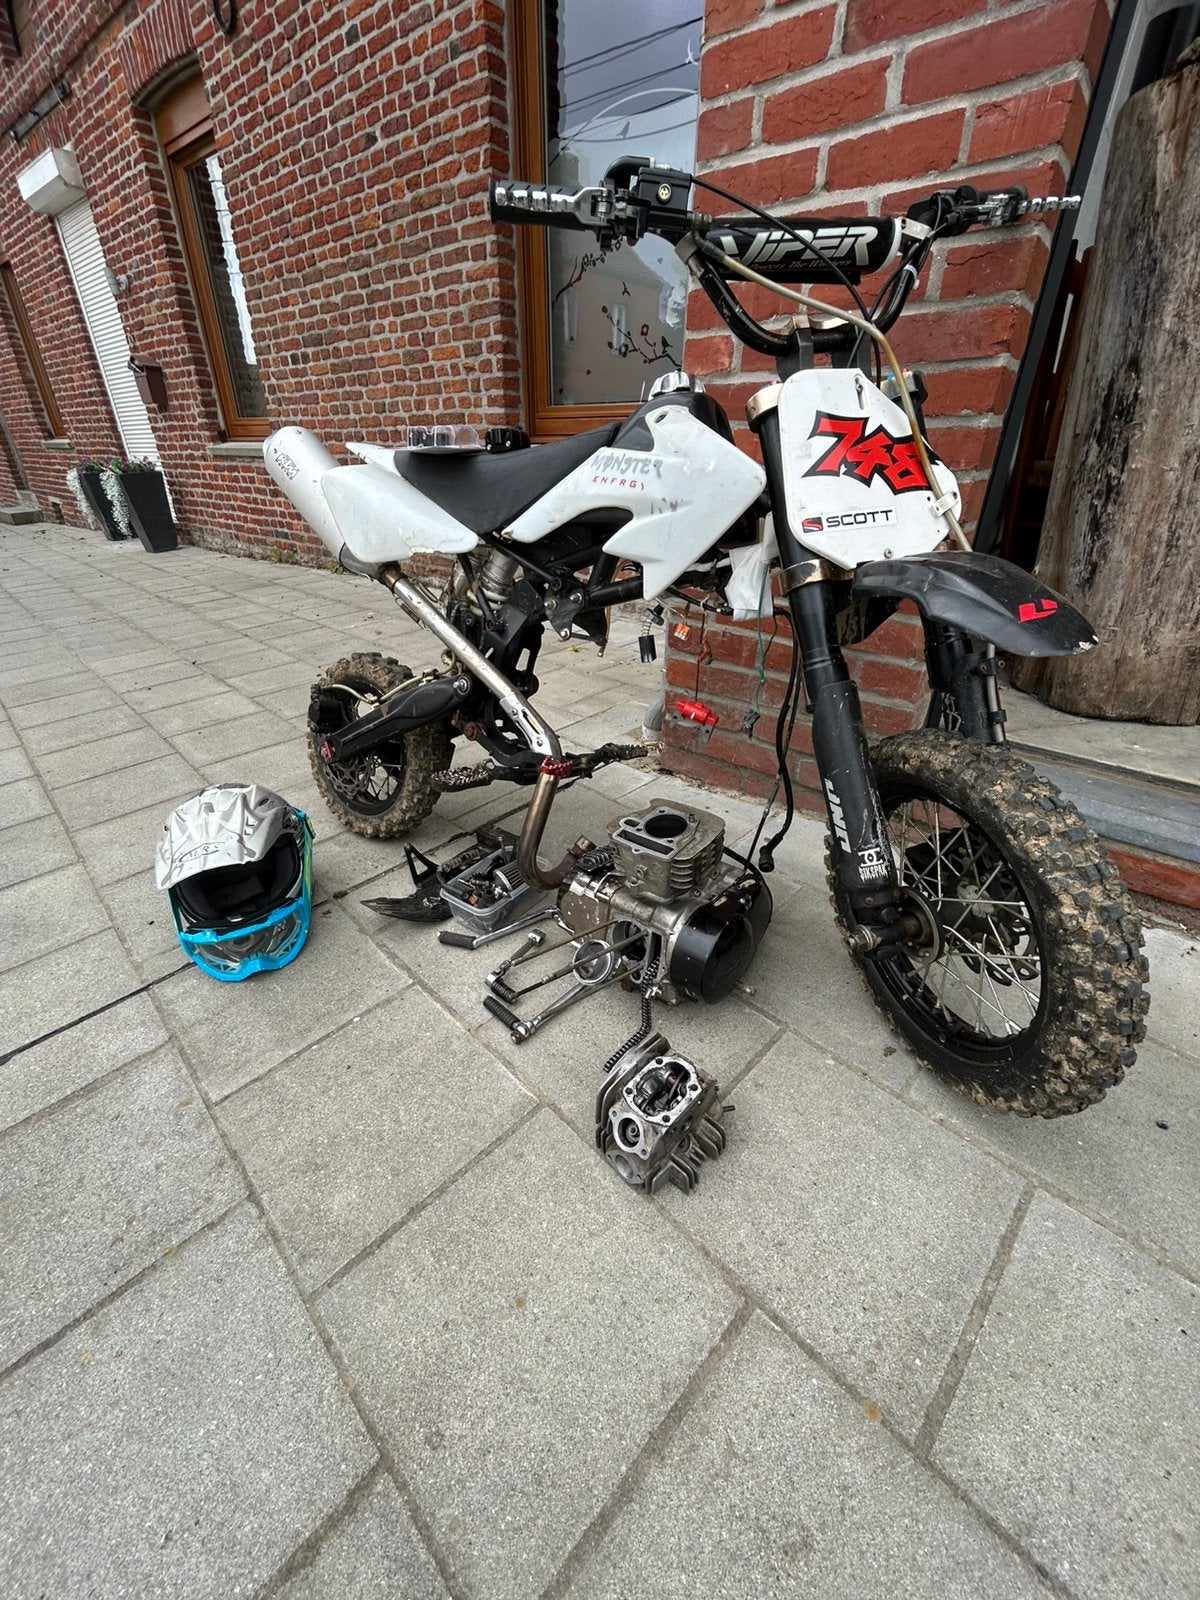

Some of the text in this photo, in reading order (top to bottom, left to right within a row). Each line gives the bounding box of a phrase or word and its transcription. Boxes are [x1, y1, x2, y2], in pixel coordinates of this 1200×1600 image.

[719, 225, 879, 268] VIPER
[801, 410, 942, 496] 748
[826, 509, 893, 528] SCOTT
